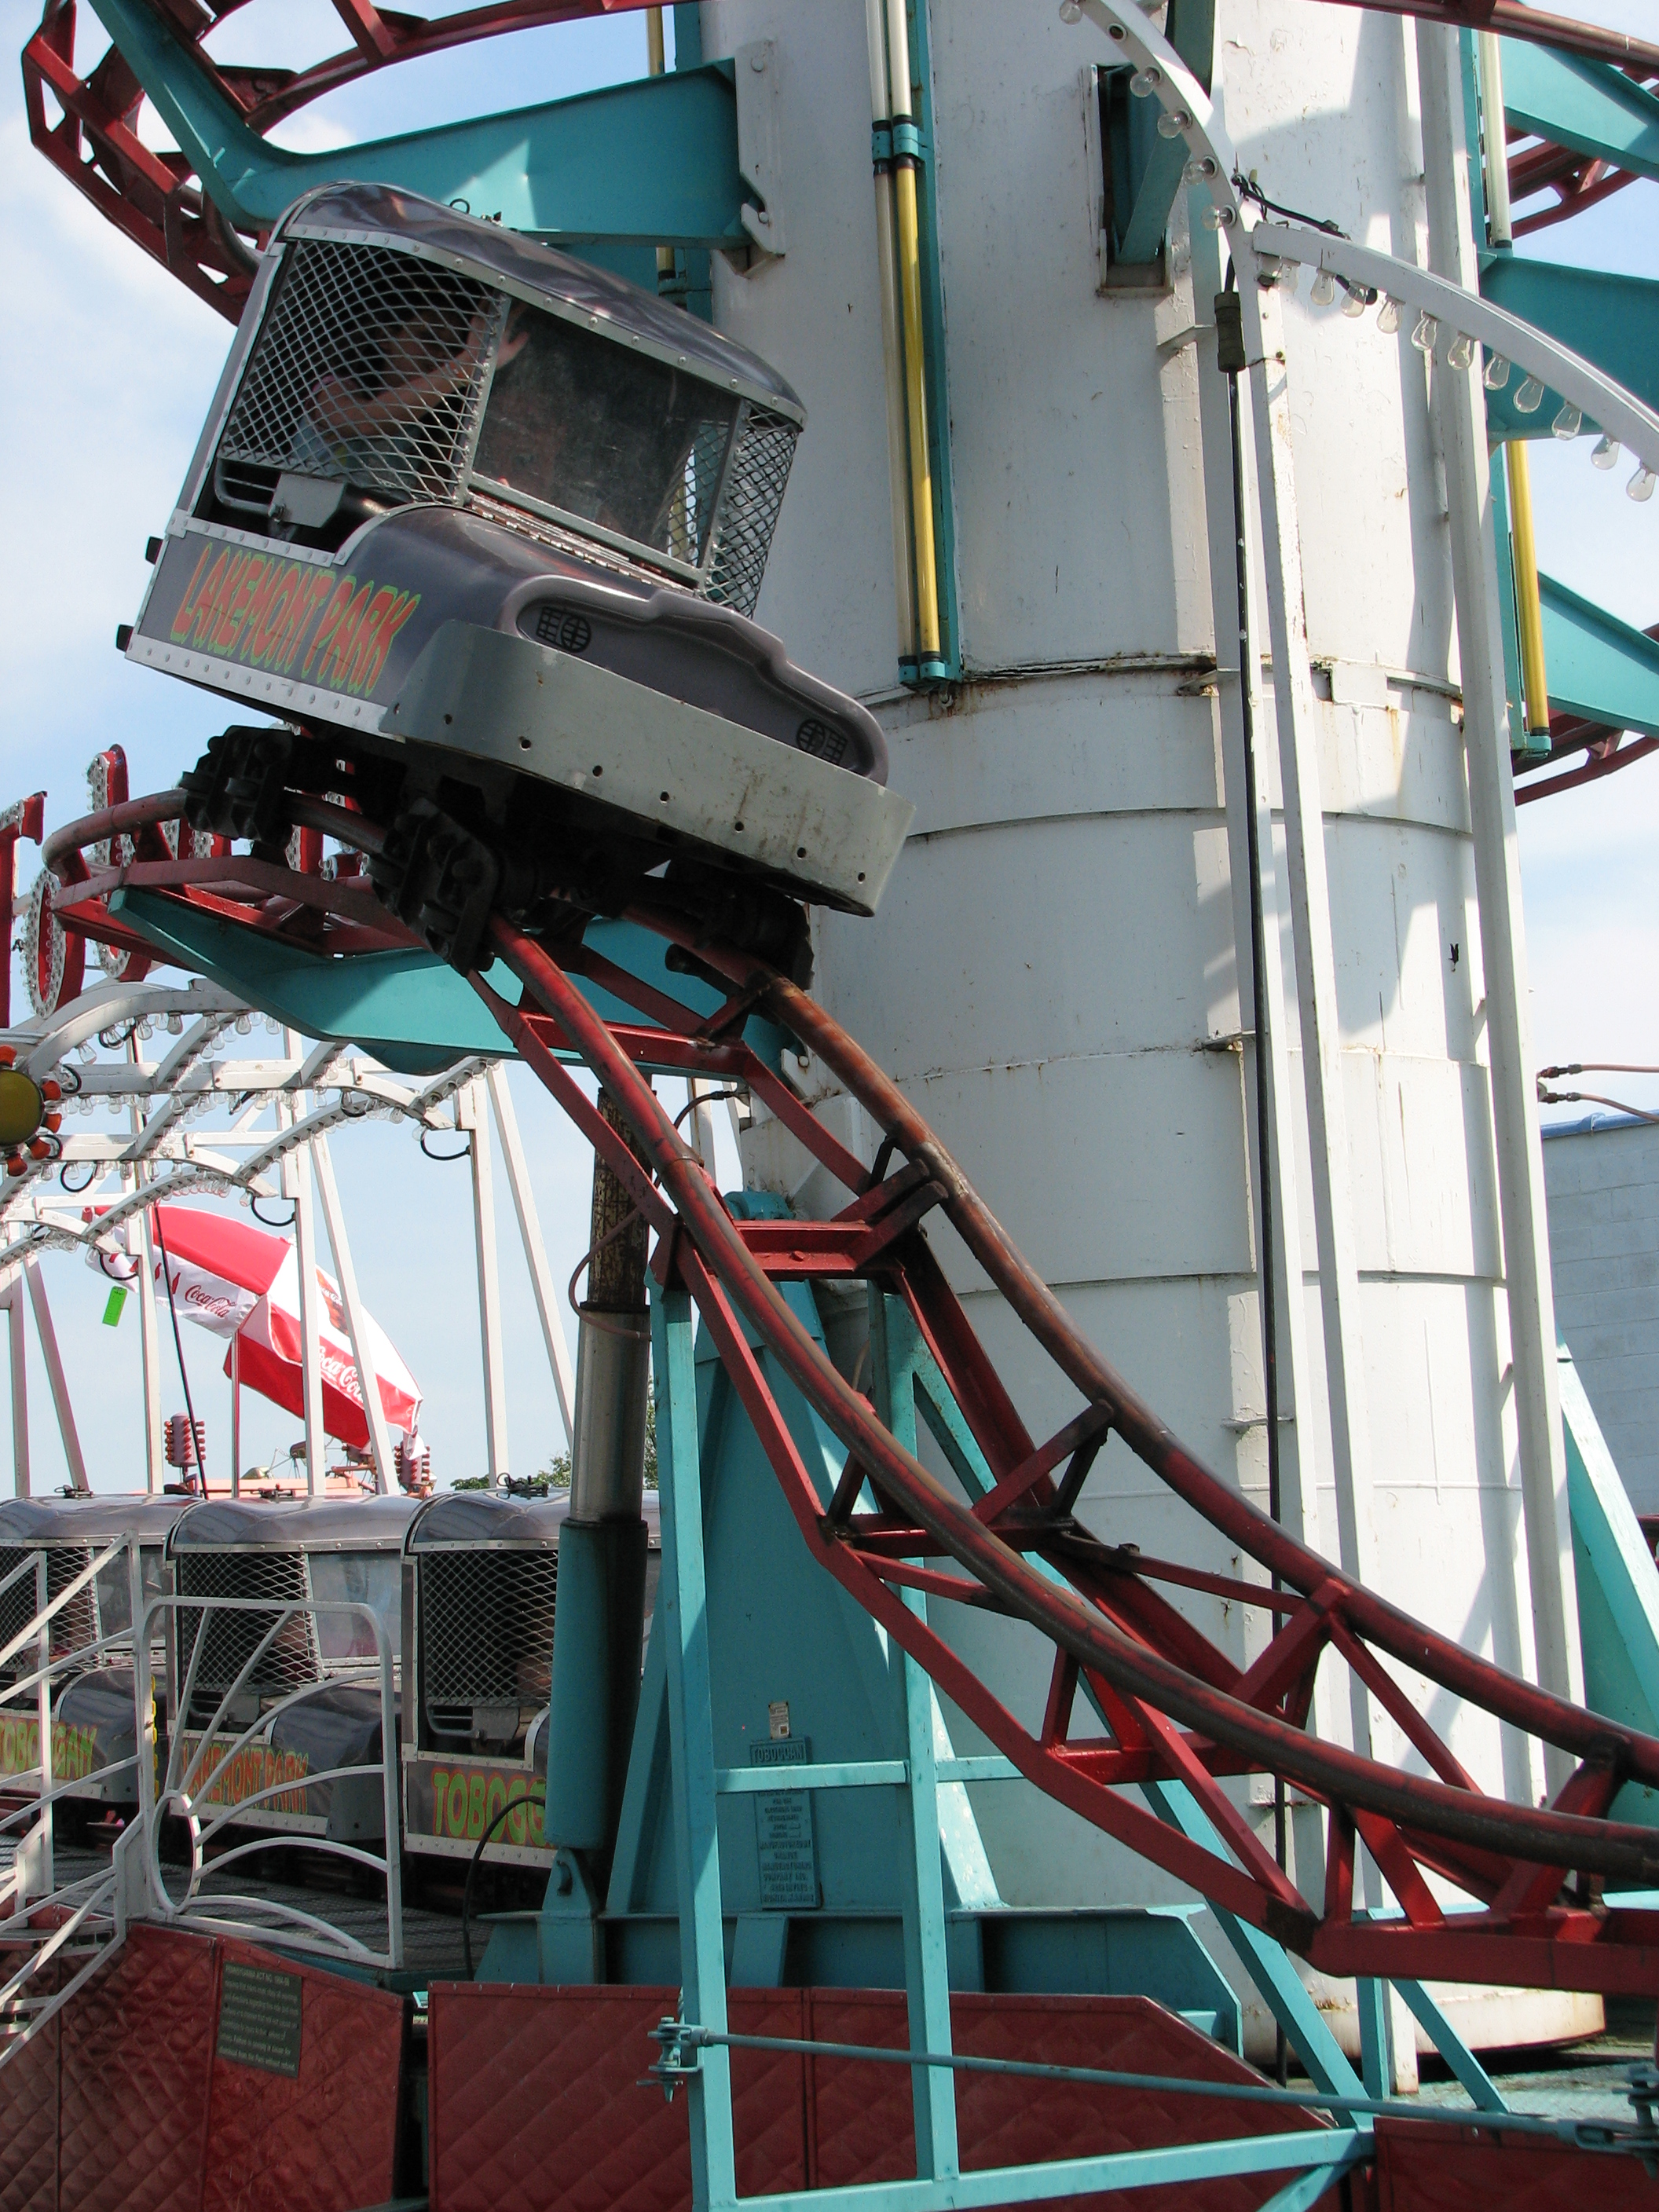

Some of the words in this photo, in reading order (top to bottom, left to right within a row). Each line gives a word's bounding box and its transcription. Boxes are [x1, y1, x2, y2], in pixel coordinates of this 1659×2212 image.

[170, 542, 336, 674] LAKEMONT
[301, 576, 421, 698] PARK
[185, 1284, 236, 1318] Coca-Cola
[0, 1718, 98, 1779] OBOGAN
[264, 1746, 309, 1815] PARK
